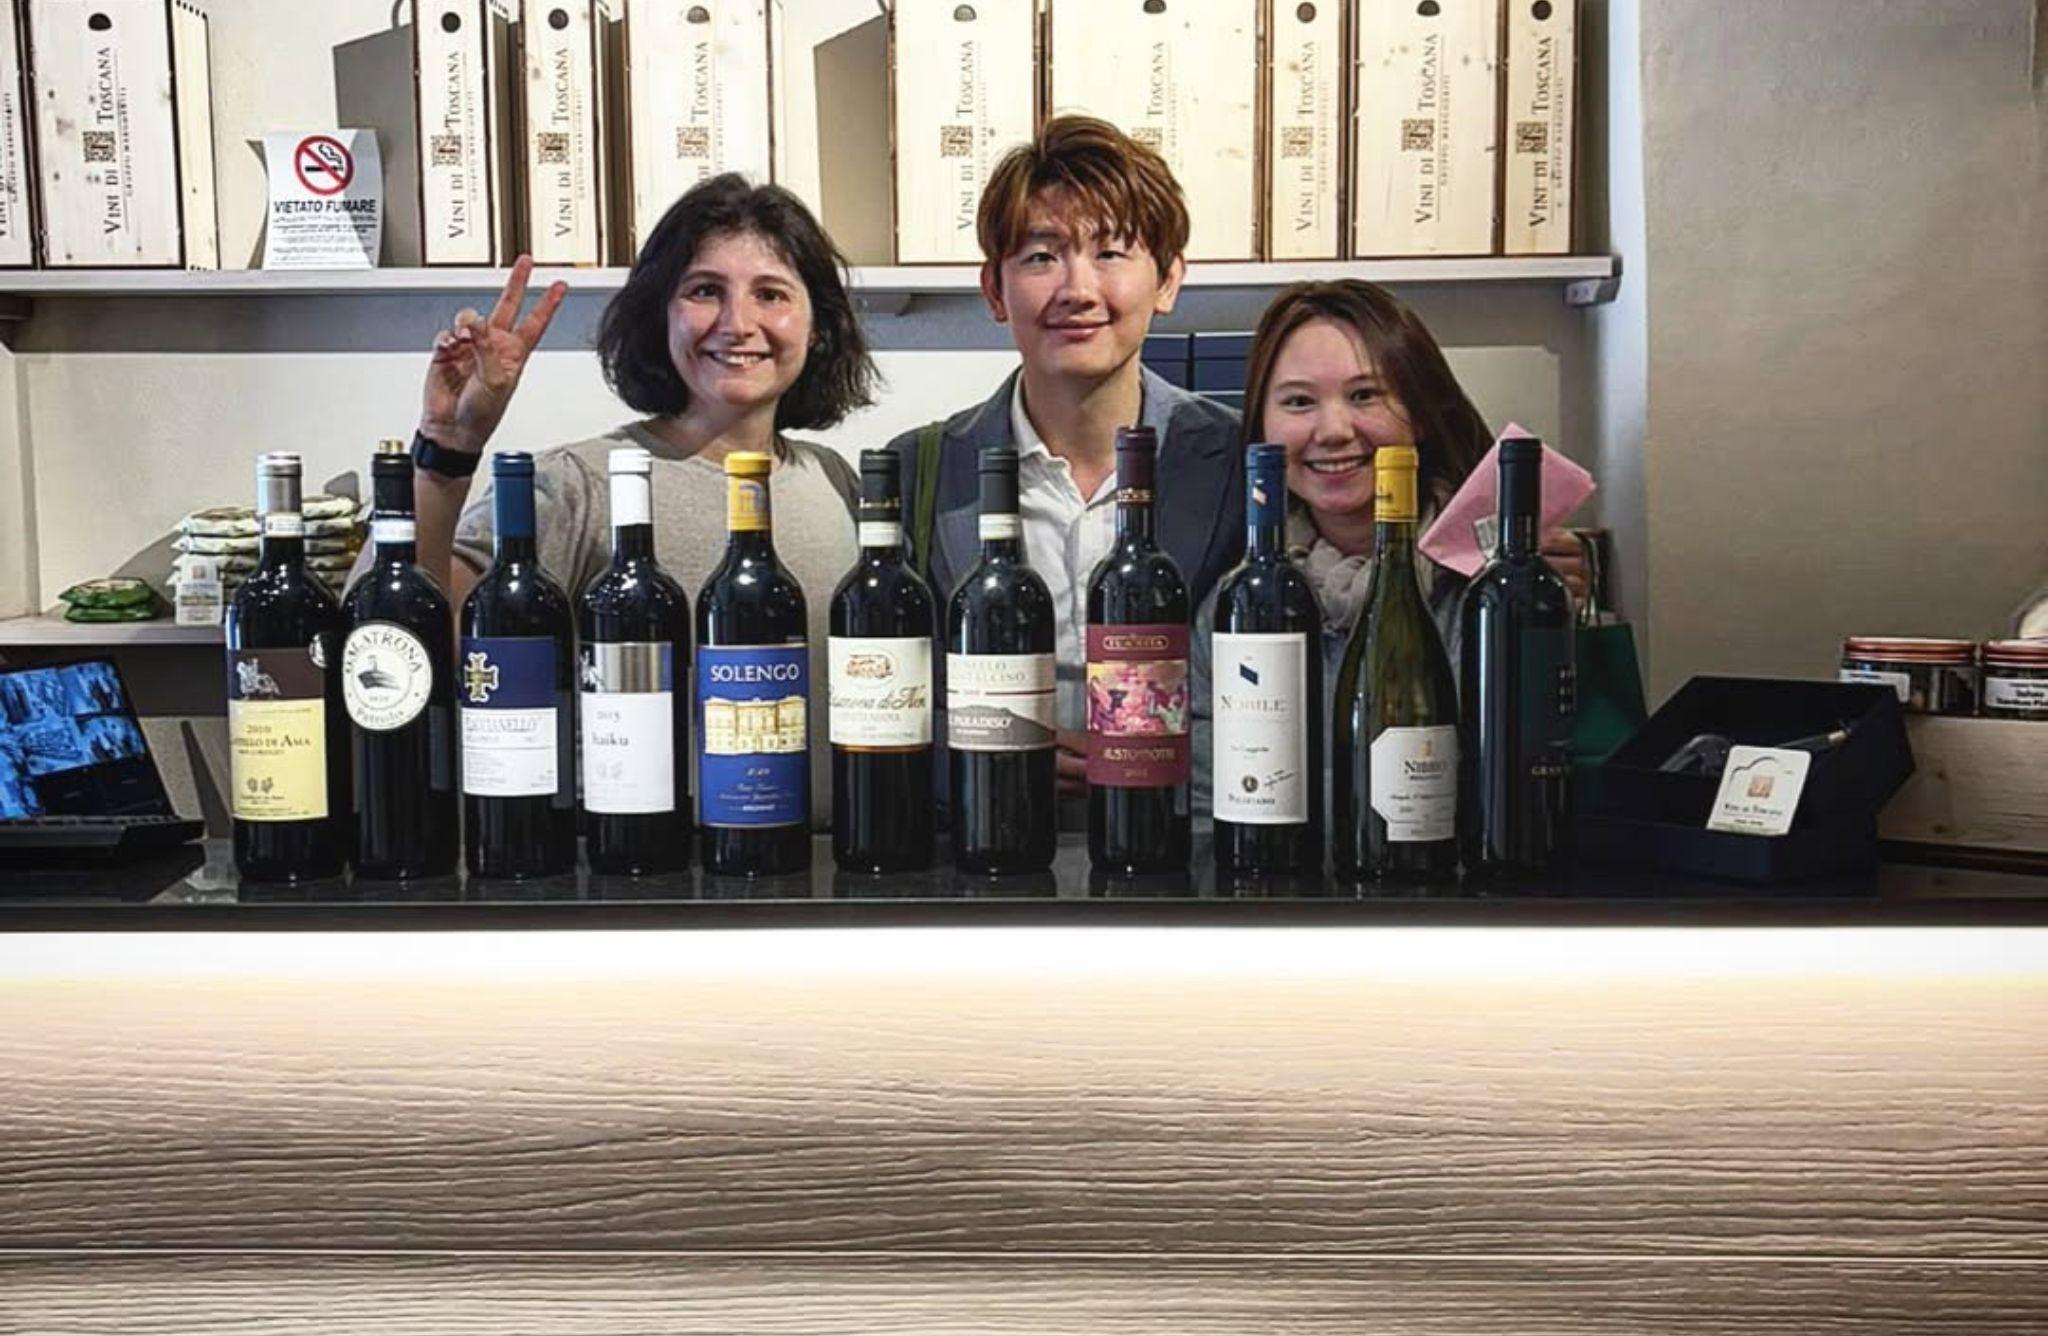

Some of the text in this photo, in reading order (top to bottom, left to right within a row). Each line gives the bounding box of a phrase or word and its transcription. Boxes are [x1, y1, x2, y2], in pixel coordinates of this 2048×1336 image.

[97, 47, 121, 235] VINI DI TOSCANA
[445, 51, 465, 240] VINI DI TOSCANA
[552, 47, 573, 239] VINI DI TOSCANA
[690, 41, 709, 120] TOSCANA
[955, 39, 975, 232] VINI DI TOSCANA
[1147, 42, 1164, 119] TOSCANA
[1295, 41, 1317, 233] VINI DI TOSCANA
[1415, 33, 1439, 225] VINI DI TOSCANA
[1528, 35, 1554, 229] VINI DI TOSCANA
[273, 199, 377, 215] VIETATO FUMARE
[591, 732, 630, 747] haiku
[710, 663, 800, 682] SOLENGO
